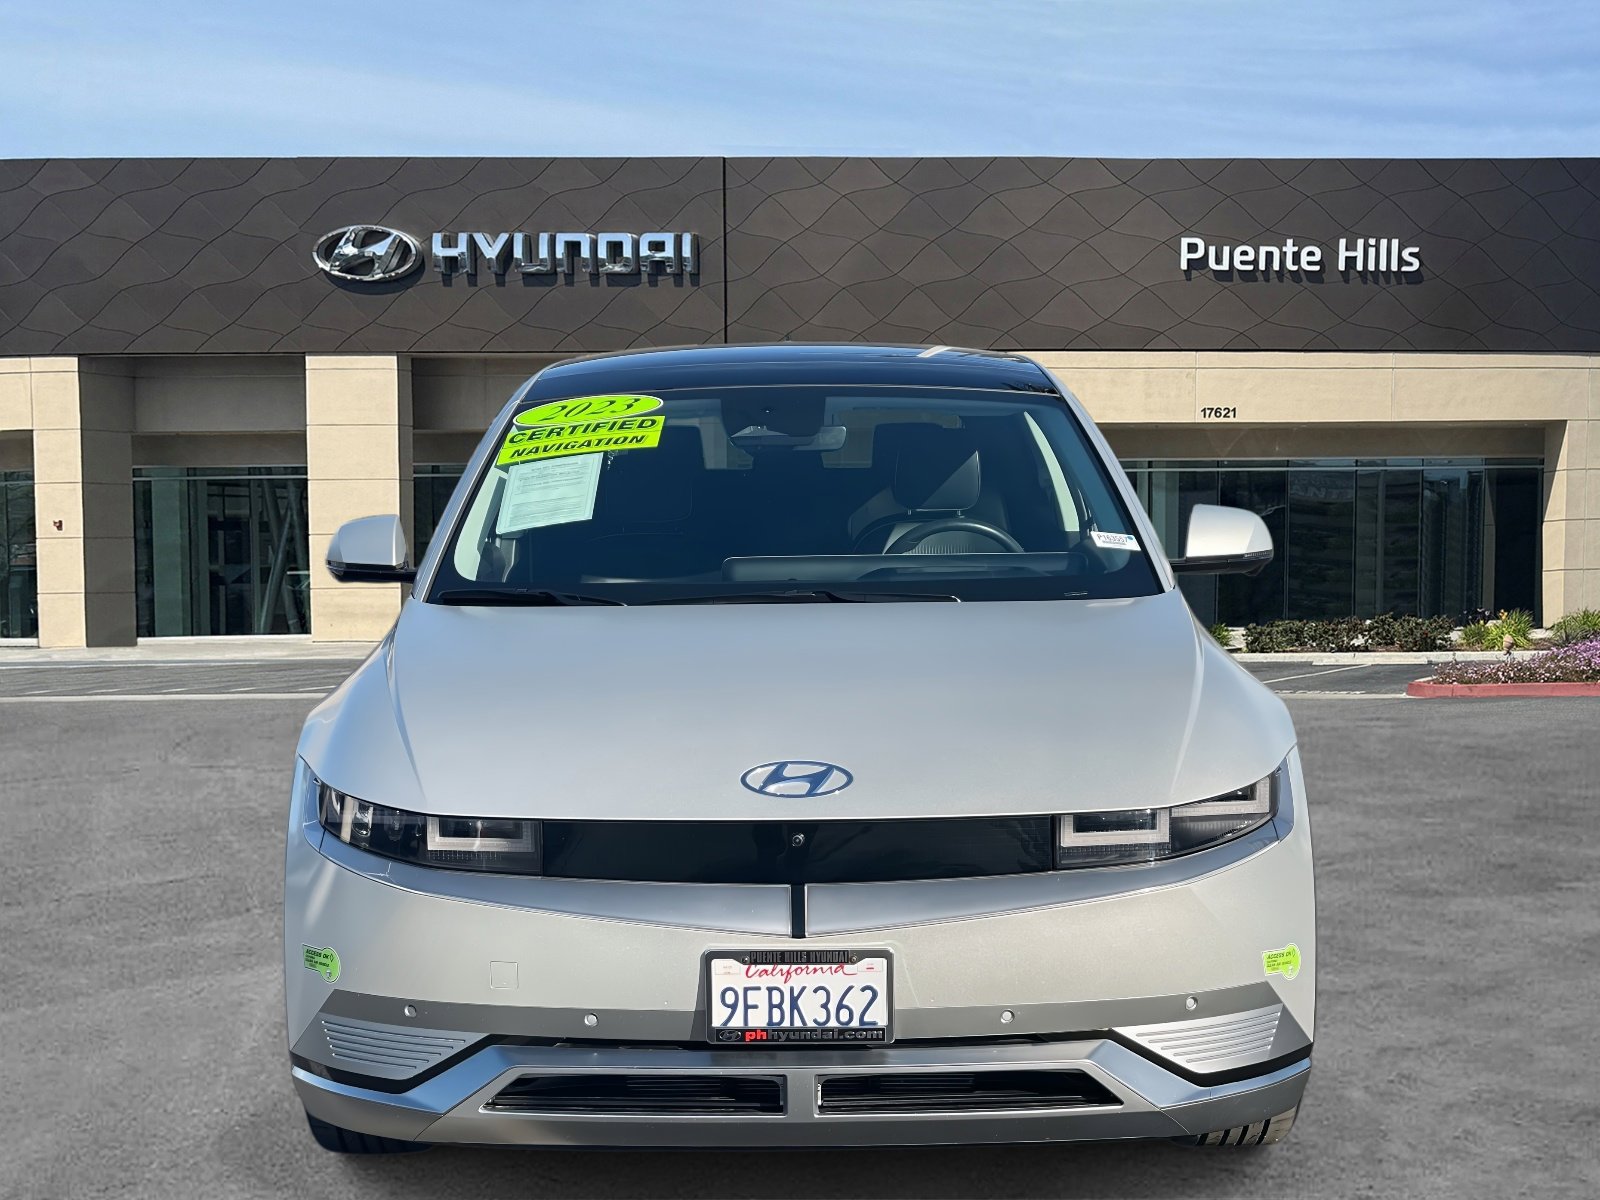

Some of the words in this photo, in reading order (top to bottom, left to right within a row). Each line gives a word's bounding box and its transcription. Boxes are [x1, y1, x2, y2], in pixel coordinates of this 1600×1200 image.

[431, 231, 697, 274] HYUNDAI
[1179, 237, 1322, 271] Puente
[1337, 237, 1421, 272] Hills
[539, 398, 641, 421] 2023
[1200, 406, 1237, 419] 17621
[508, 417, 659, 444] CERTIFIED
[509, 435, 646, 459] NAVIGATION
[750, 950, 782, 963] PUENTE
[784, 950, 807, 963] HILLS
[809, 950, 849, 963] HYUNDAI
[744, 963, 858, 984] California
[719, 984, 879, 1027] 9FBK362
[744, 1028, 883, 1042] phhyundai.com
